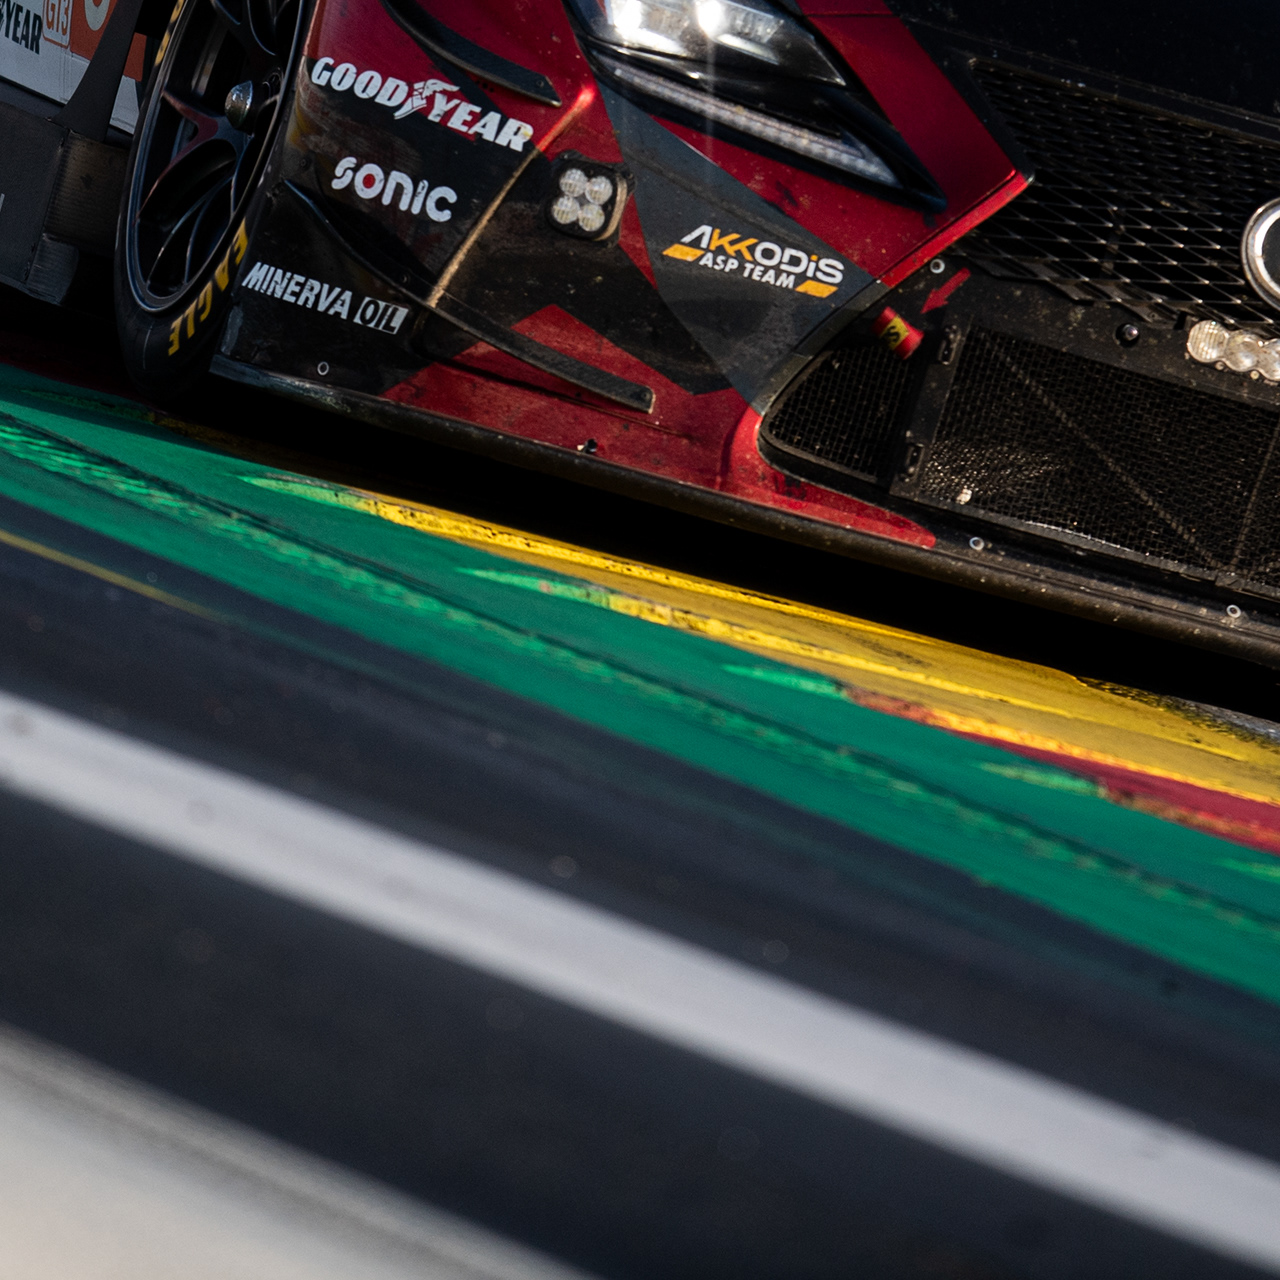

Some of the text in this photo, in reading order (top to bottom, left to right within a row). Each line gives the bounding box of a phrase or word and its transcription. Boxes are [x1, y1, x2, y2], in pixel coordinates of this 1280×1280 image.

[311, 56, 534, 152] GOODYEAR
[680, 224, 846, 285] AKKODIS
[699, 251, 797, 290] ASP TEAM
[241, 261, 402, 334] MINERVA OIL
